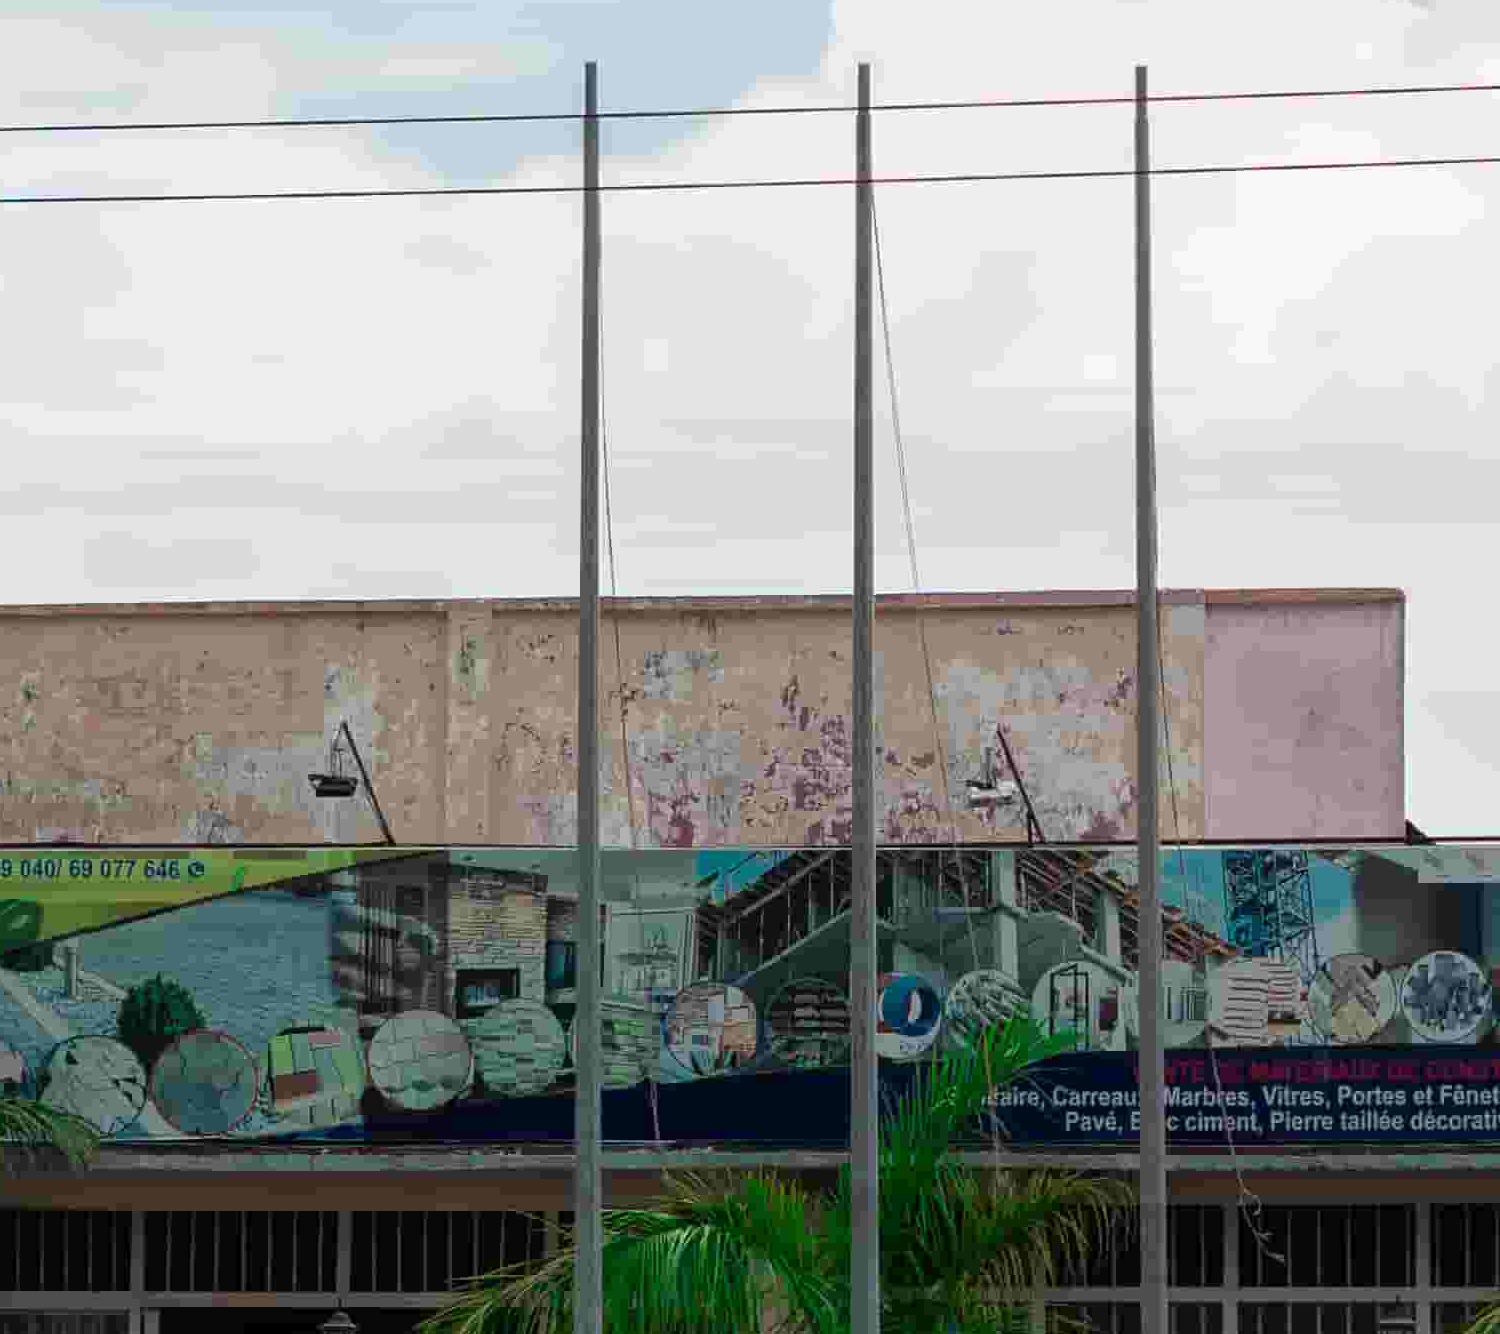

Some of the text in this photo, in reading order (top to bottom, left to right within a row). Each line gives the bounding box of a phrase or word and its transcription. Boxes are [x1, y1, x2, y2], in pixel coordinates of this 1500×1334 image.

[69, 859, 93, 878] 69
[100, 859, 135, 878] 077
[1164, 1085, 1255, 1108] Marbres,
[1260, 1084, 1331, 1110] Vitres,
[1337, 1085, 1406, 1107] Portes
[1411, 1085, 1434, 1107] et
[1064, 1110, 1123, 1135] Pavé,
[1130, 1111, 1181, 1131] Bc
[1270, 1110, 1333, 1132] Pierre
[1339, 1110, 1405, 1131] taillée
